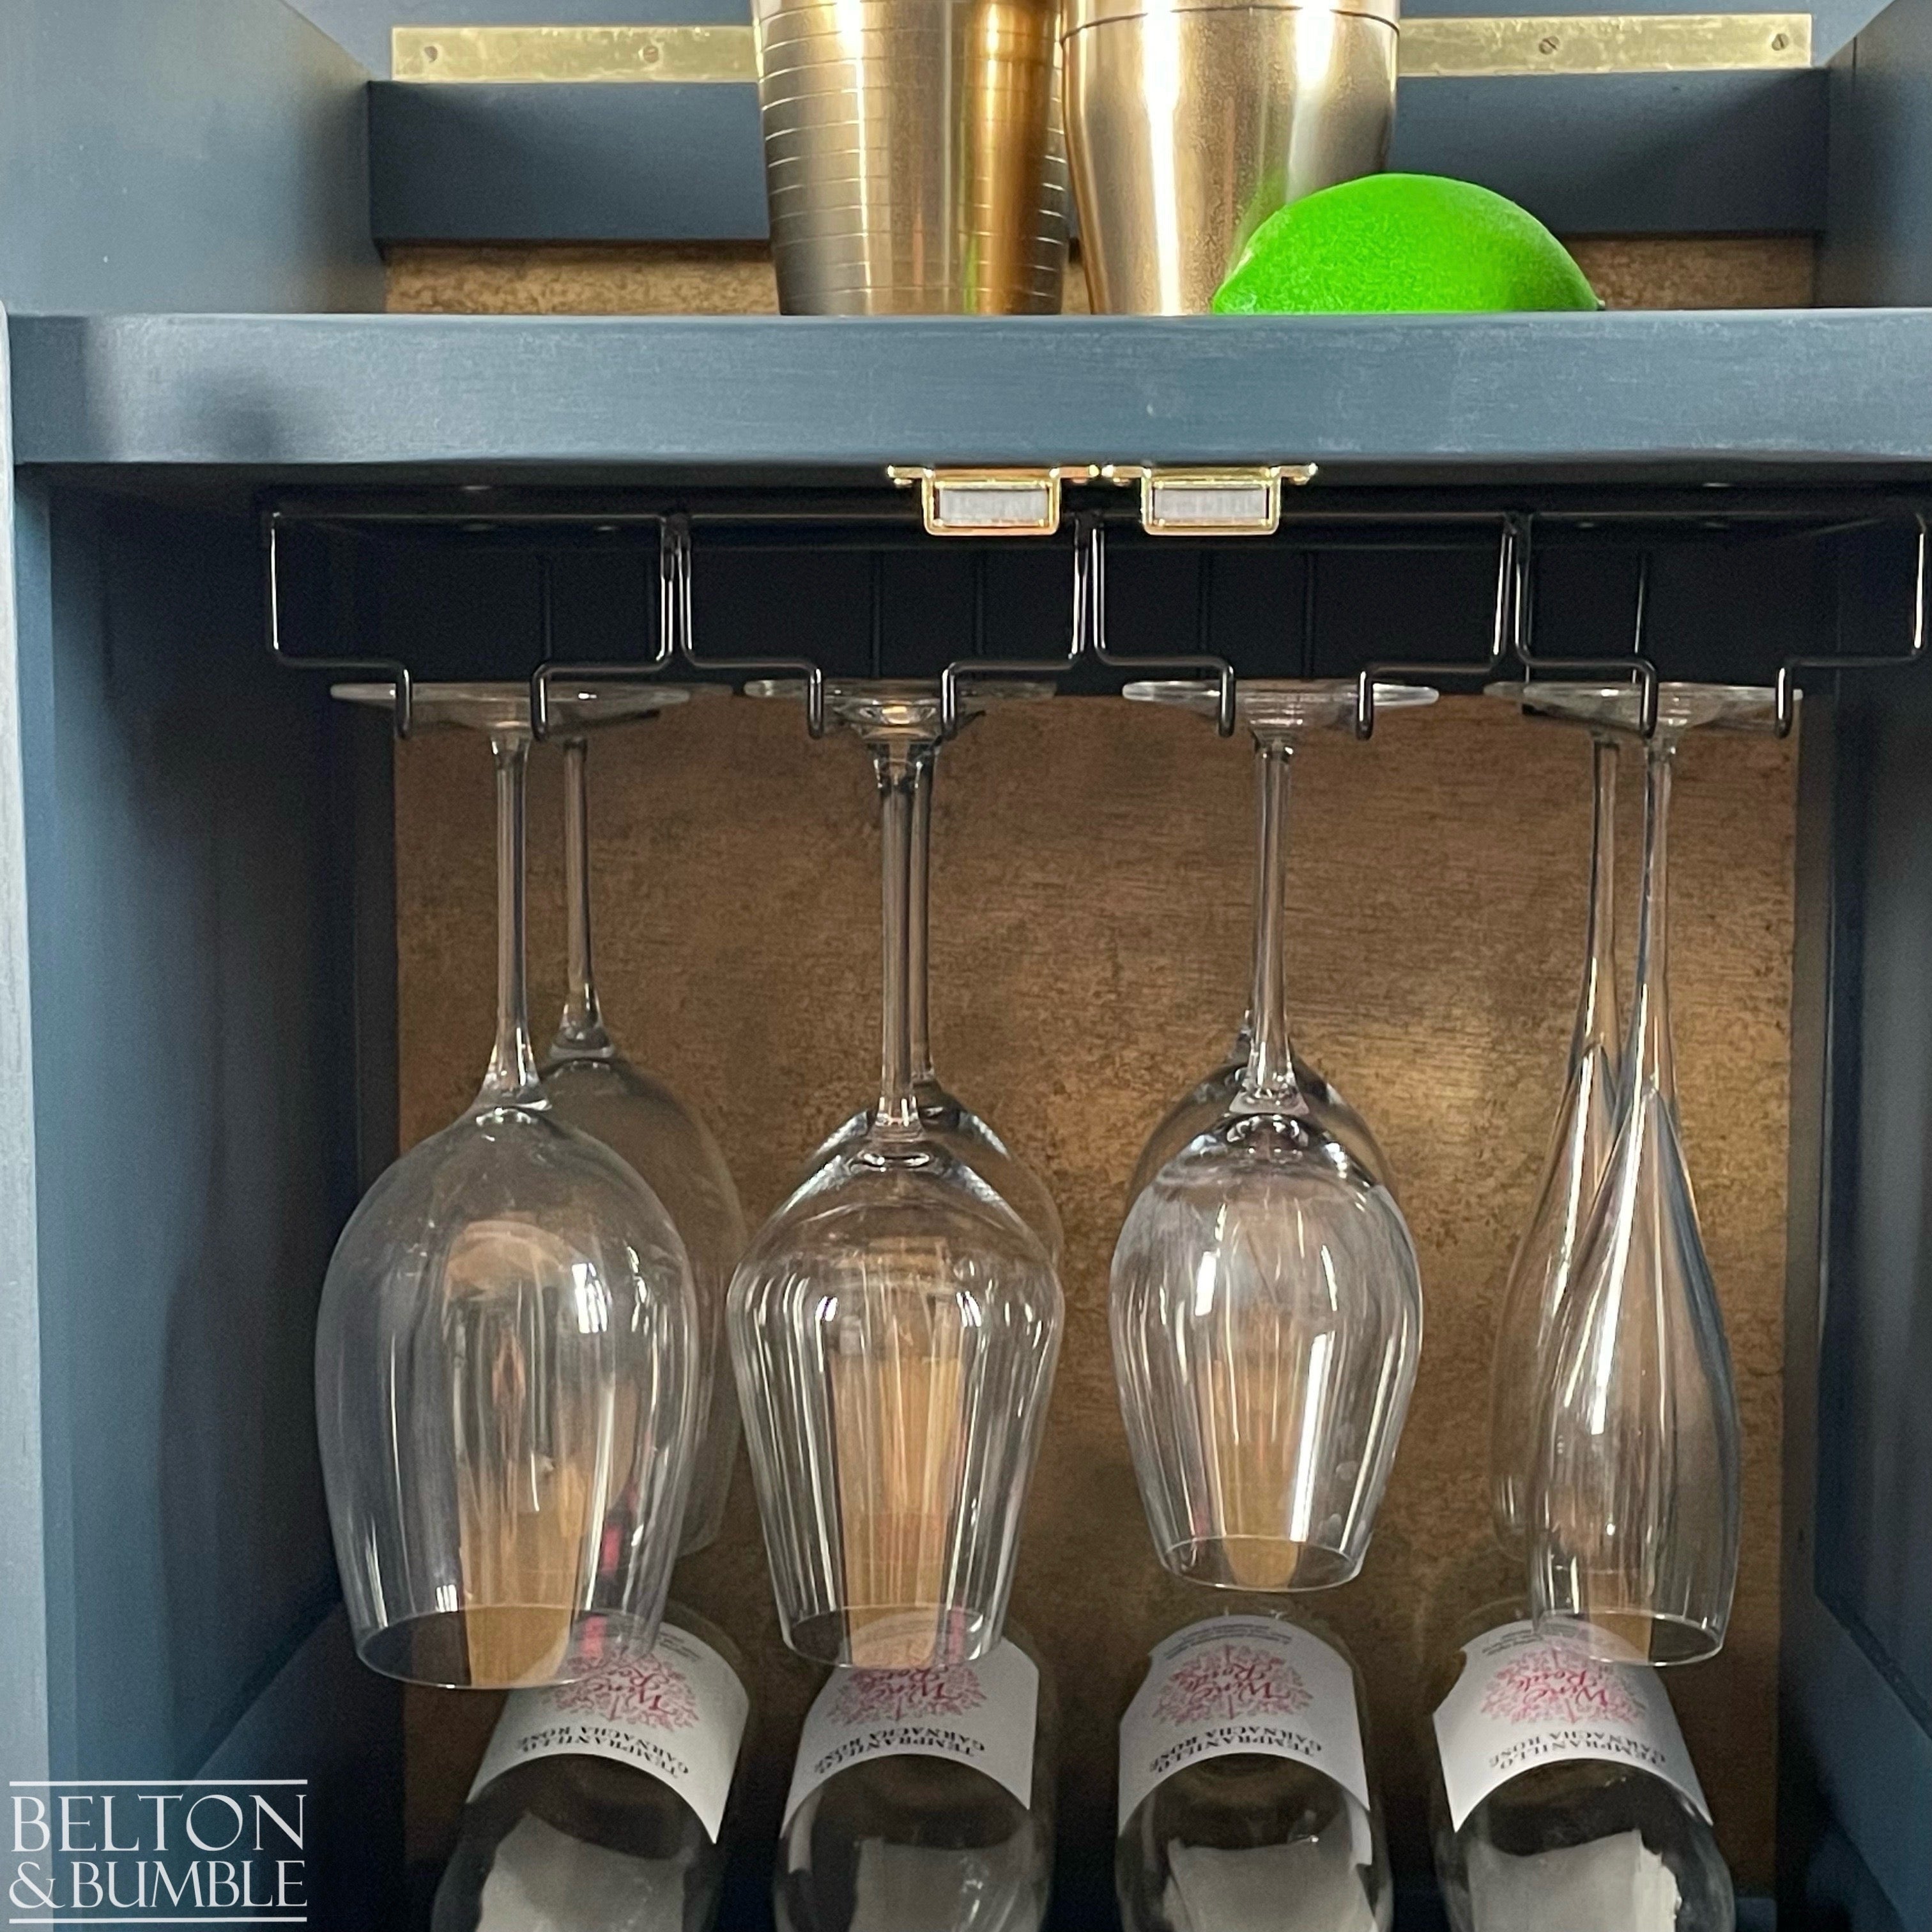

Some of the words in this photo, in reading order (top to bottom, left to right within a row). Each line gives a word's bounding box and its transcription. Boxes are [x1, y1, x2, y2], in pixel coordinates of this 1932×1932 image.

[1188, 1682, 1291, 1705] Wine
[1522, 1685, 1608, 1708] Wine
[579, 1725, 689, 1775] GARNACHA
[1204, 1726, 1322, 1752] GARNACHA
